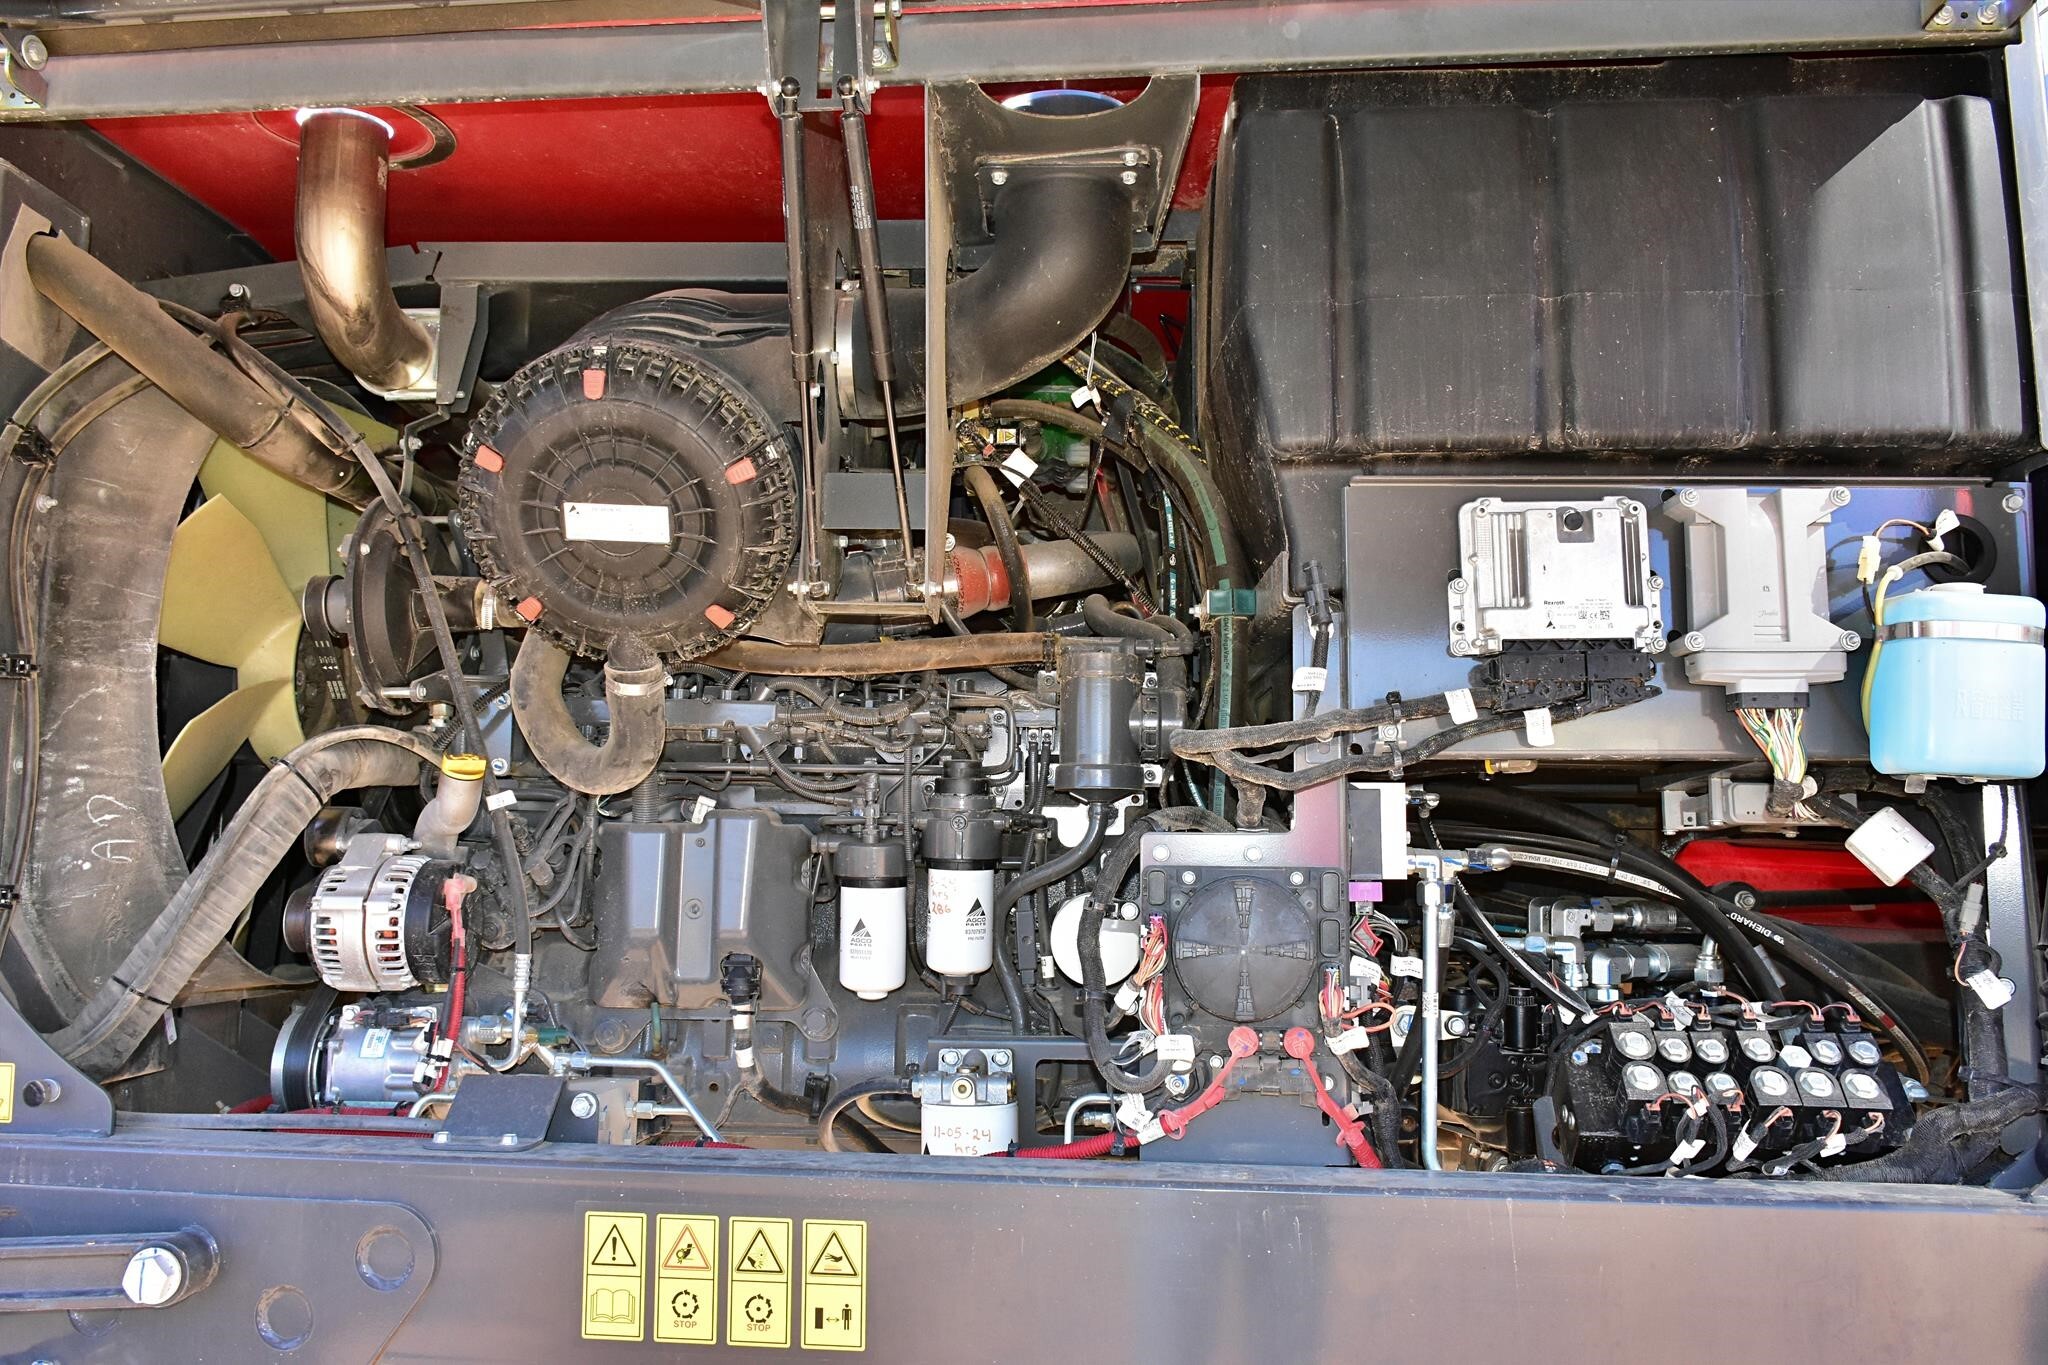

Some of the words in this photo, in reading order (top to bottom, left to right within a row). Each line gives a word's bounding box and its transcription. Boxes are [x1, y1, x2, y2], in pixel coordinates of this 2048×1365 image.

[954, 1143, 978, 1155] hrs
[673, 1320, 697, 1329] STOP
[746, 1323, 771, 1332] STOP
